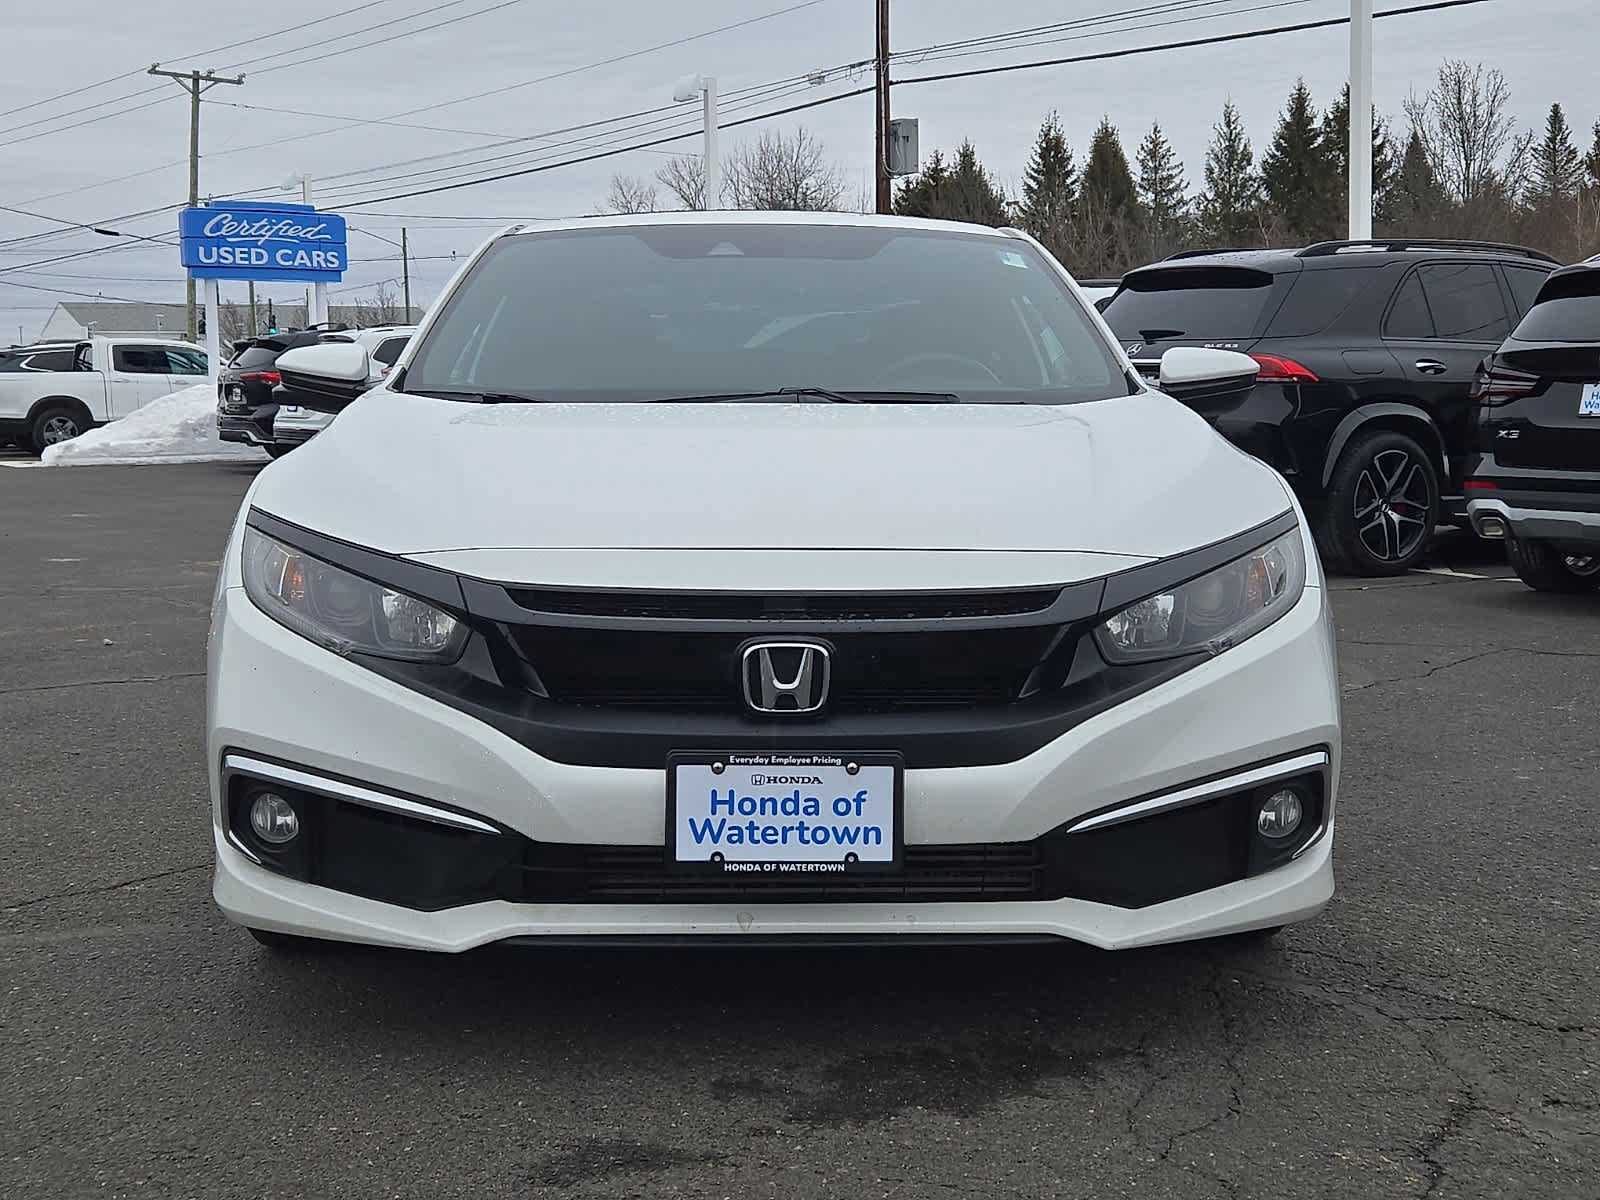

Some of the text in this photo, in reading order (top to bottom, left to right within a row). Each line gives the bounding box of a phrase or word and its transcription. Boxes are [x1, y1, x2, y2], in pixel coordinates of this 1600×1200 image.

[203, 213, 332, 246] Certified
[198, 246, 340, 268] USED CARS
[1496, 429, 1520, 439] X3
[729, 755, 842, 766] Everyday Employee Pricing
[766, 776, 824, 785] HONDA
[710, 789, 868, 816] Honda of
[688, 817, 882, 845] Watertown
[723, 863, 846, 872] HONDA OF WATERTOWN
